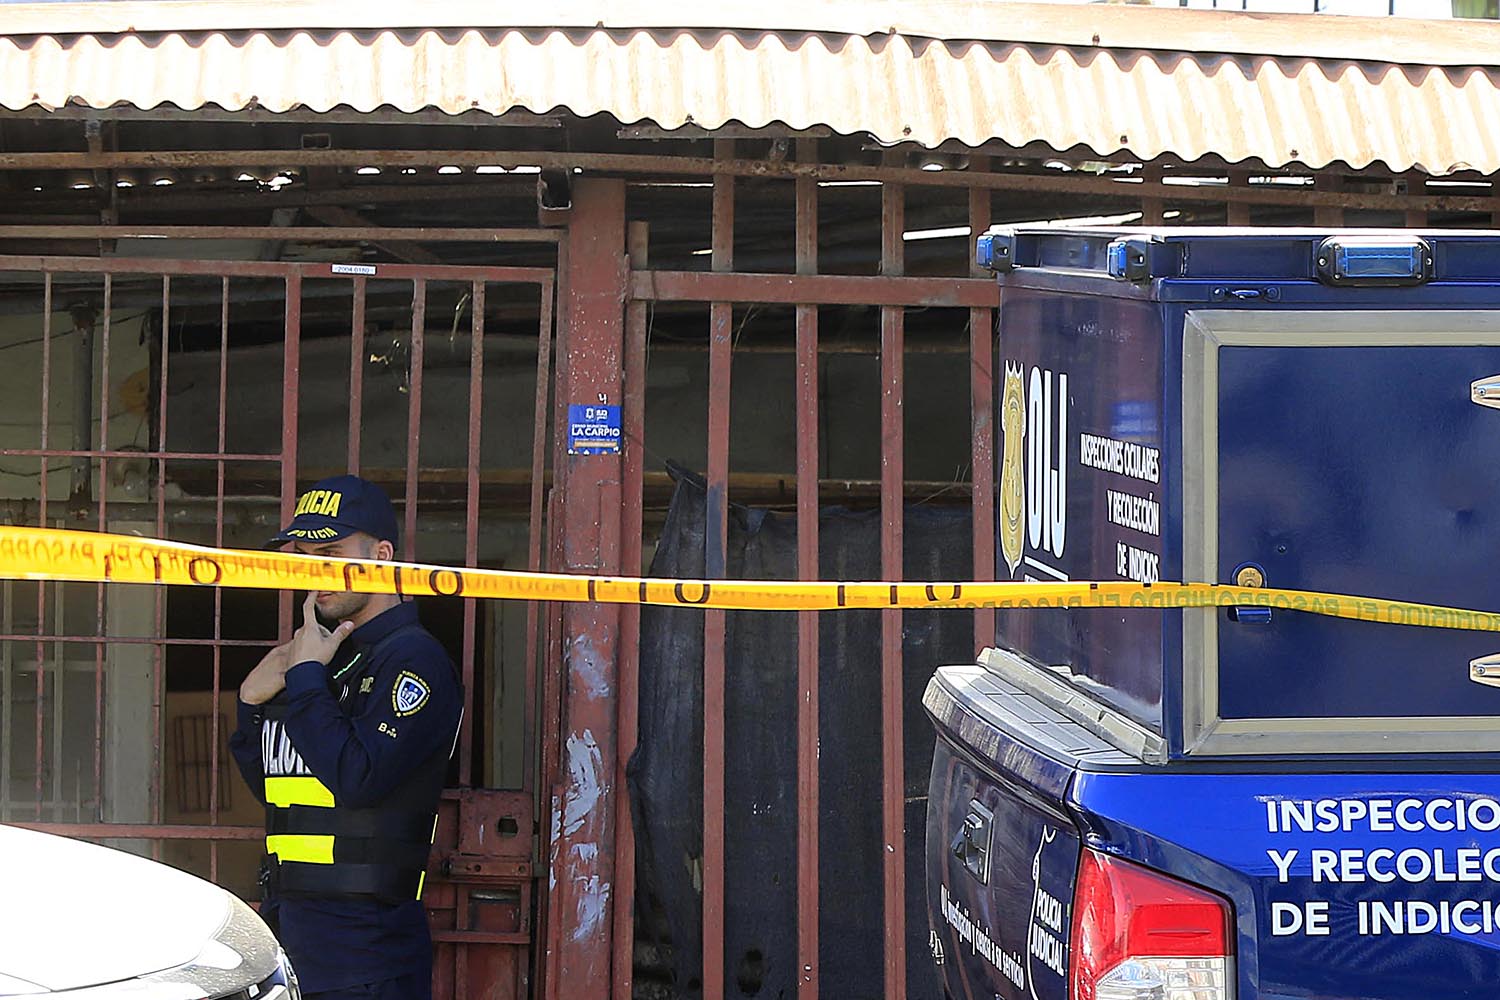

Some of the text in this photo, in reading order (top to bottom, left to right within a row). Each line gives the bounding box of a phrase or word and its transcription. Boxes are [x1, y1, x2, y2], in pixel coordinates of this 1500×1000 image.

[571, 426, 621, 438] LA CARPIO
[1027, 366, 1068, 559] OIJ
[1080, 432, 1160, 484] INSPECCIONES OCULARES
[286, 526, 338, 540] POLICIA
[1106, 489, 1160, 537] Y RECOLECCIÓN
[1116, 539, 1160, 584] DE INDICIOS
[1266, 849, 1299, 884] Y
[1036, 888, 1063, 934] POLICIA
[1271, 902, 1330, 936] DE
[1030, 921, 1065, 977] JUDICIAL
